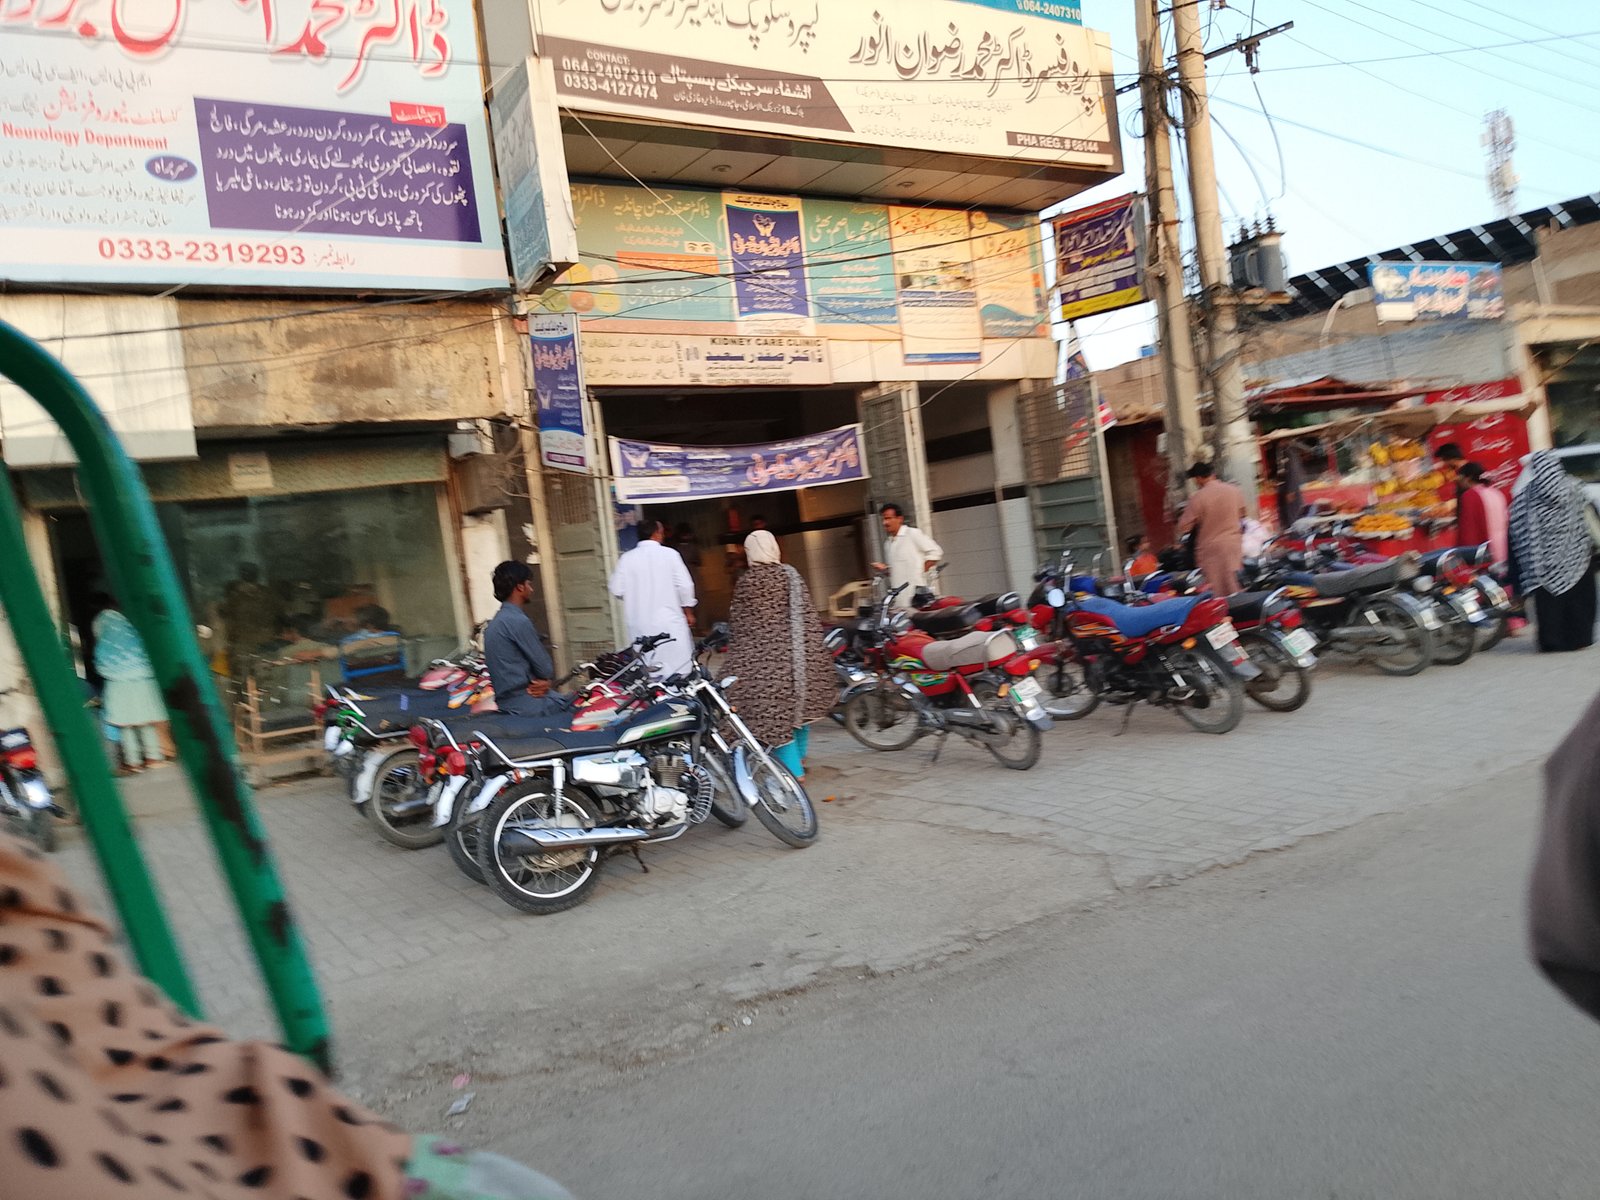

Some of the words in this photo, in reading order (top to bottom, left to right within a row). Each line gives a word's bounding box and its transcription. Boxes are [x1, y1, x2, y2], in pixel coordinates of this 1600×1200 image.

[848, 9, 891, 65] انور
[894, 21, 962, 79] رضوان
[561, 55, 658, 85] 064-2407310
[962, 31, 1001, 80] محمد
[987, 26, 1033, 97] ڈاکٹر
[563, 73, 660, 100] 0333-4127474
[1026, 32, 1094, 116] پروفیسر
[774, 81, 812, 100] الشفاء
[3, 121, 79, 148] Neurology
[84, 128, 168, 149] Department
[98, 238, 304, 265] 0333-2319293
[710, 337, 751, 346] KIDNEY
[755, 338, 785, 347] CARE
